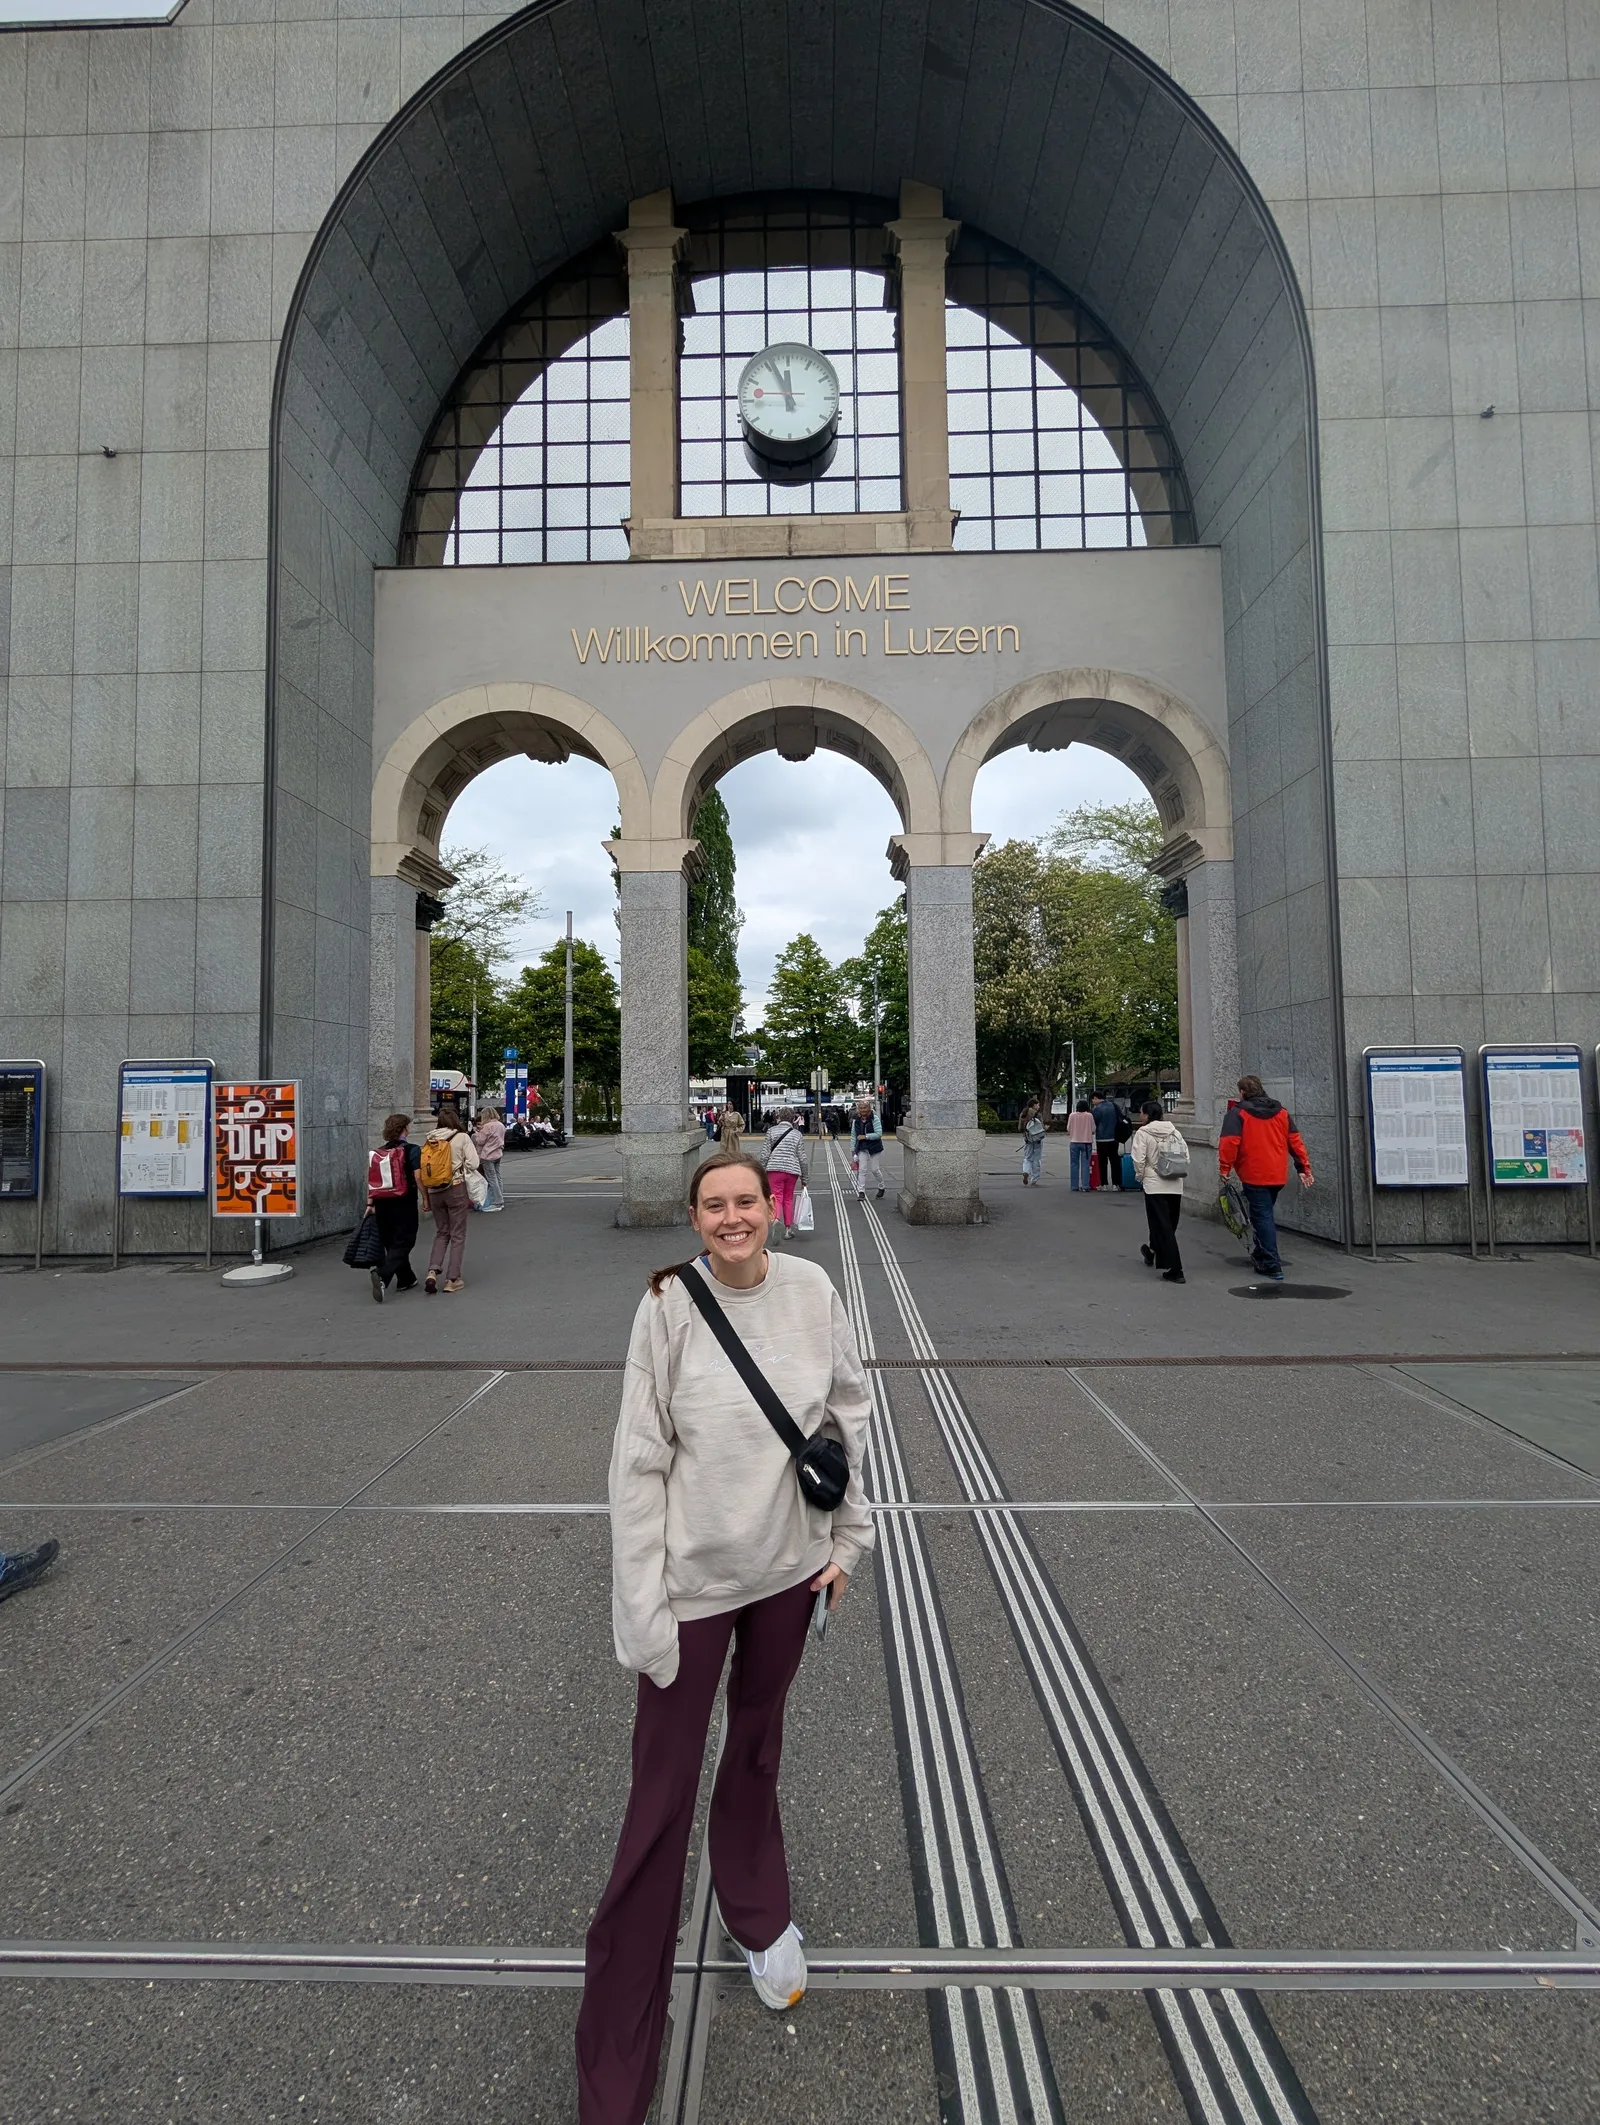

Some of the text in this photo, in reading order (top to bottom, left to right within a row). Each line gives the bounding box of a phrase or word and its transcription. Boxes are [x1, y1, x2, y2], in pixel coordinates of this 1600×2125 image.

[678, 573, 911, 616] WELCOME
[571, 618, 1021, 664] Willkommen in Luzern
